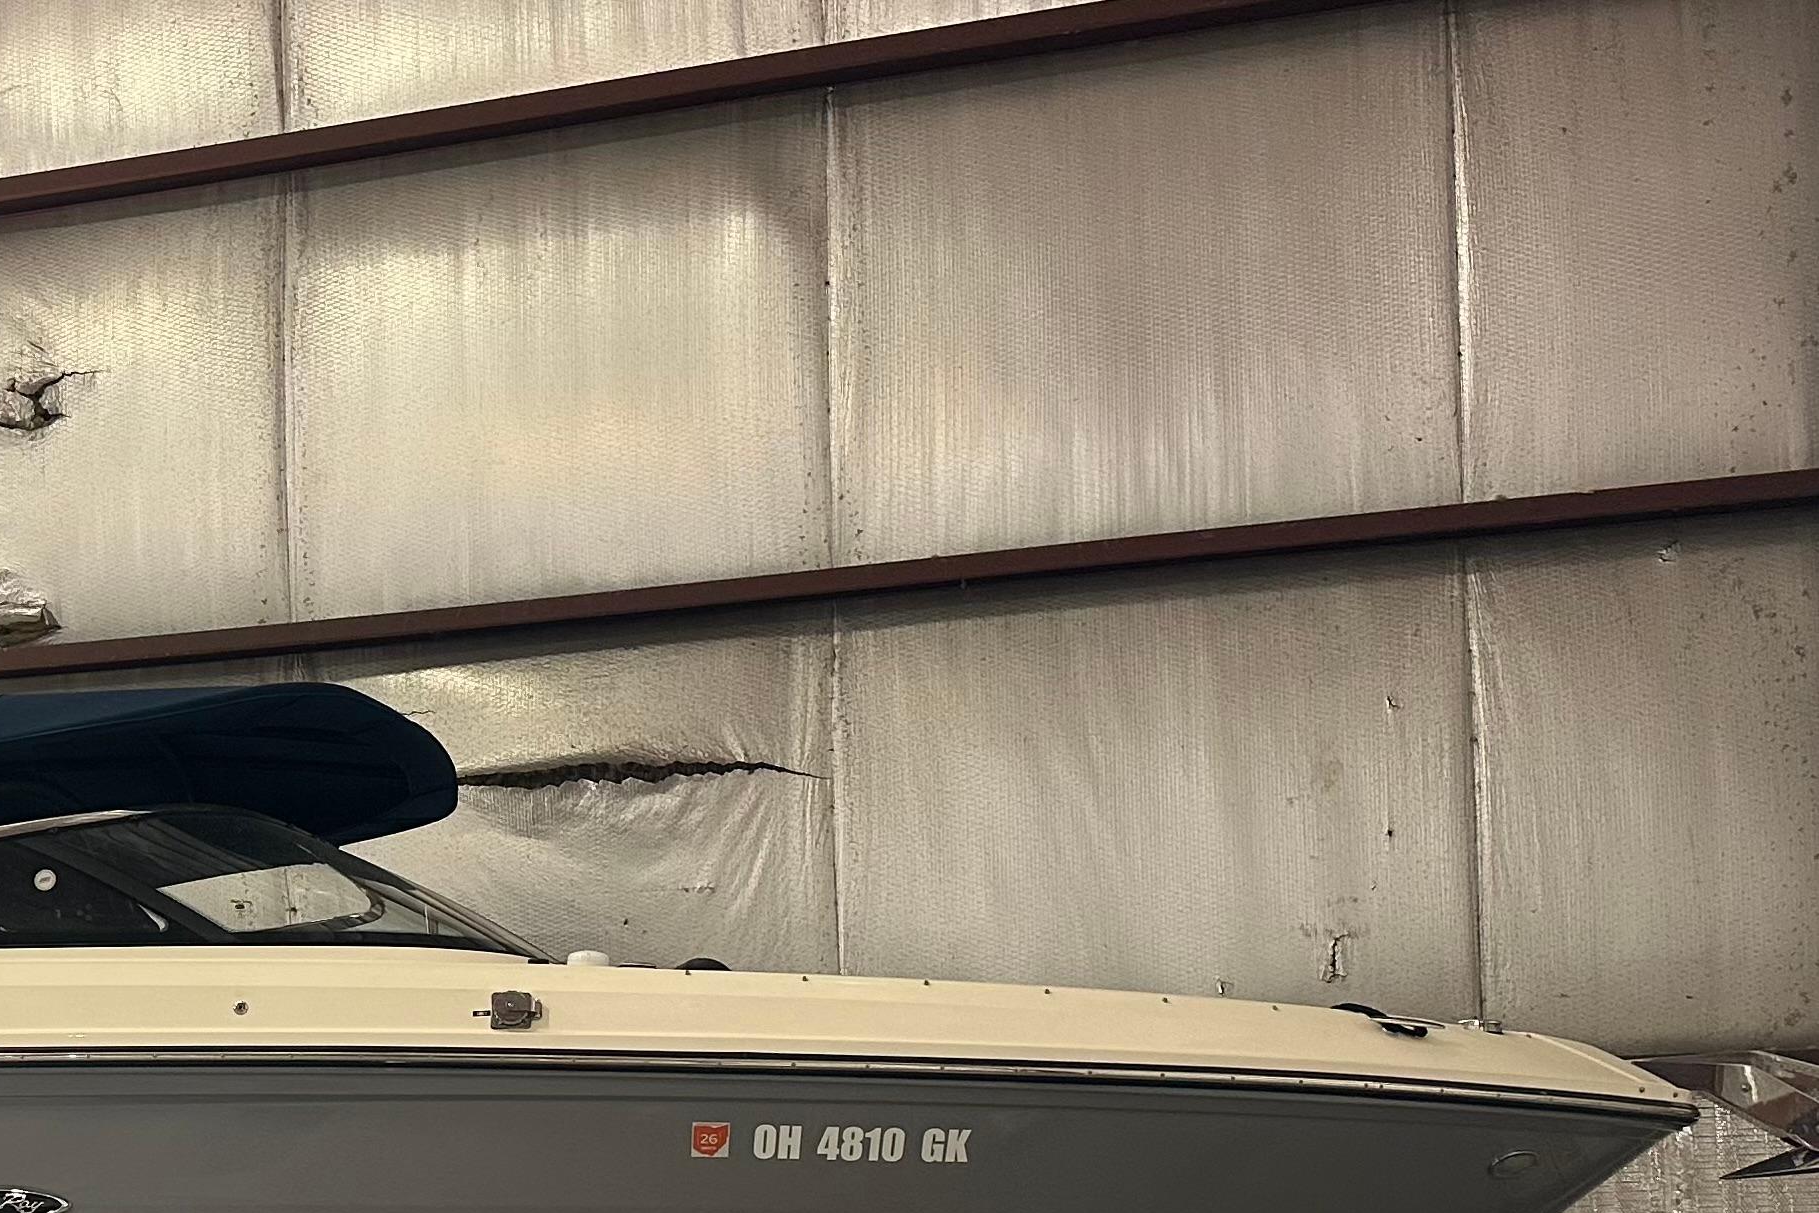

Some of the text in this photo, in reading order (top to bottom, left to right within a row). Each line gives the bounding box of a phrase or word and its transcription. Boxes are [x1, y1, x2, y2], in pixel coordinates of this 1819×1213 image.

[700, 1133, 719, 1145] 26
[753, 1124, 972, 1163] OH 4810 GK
